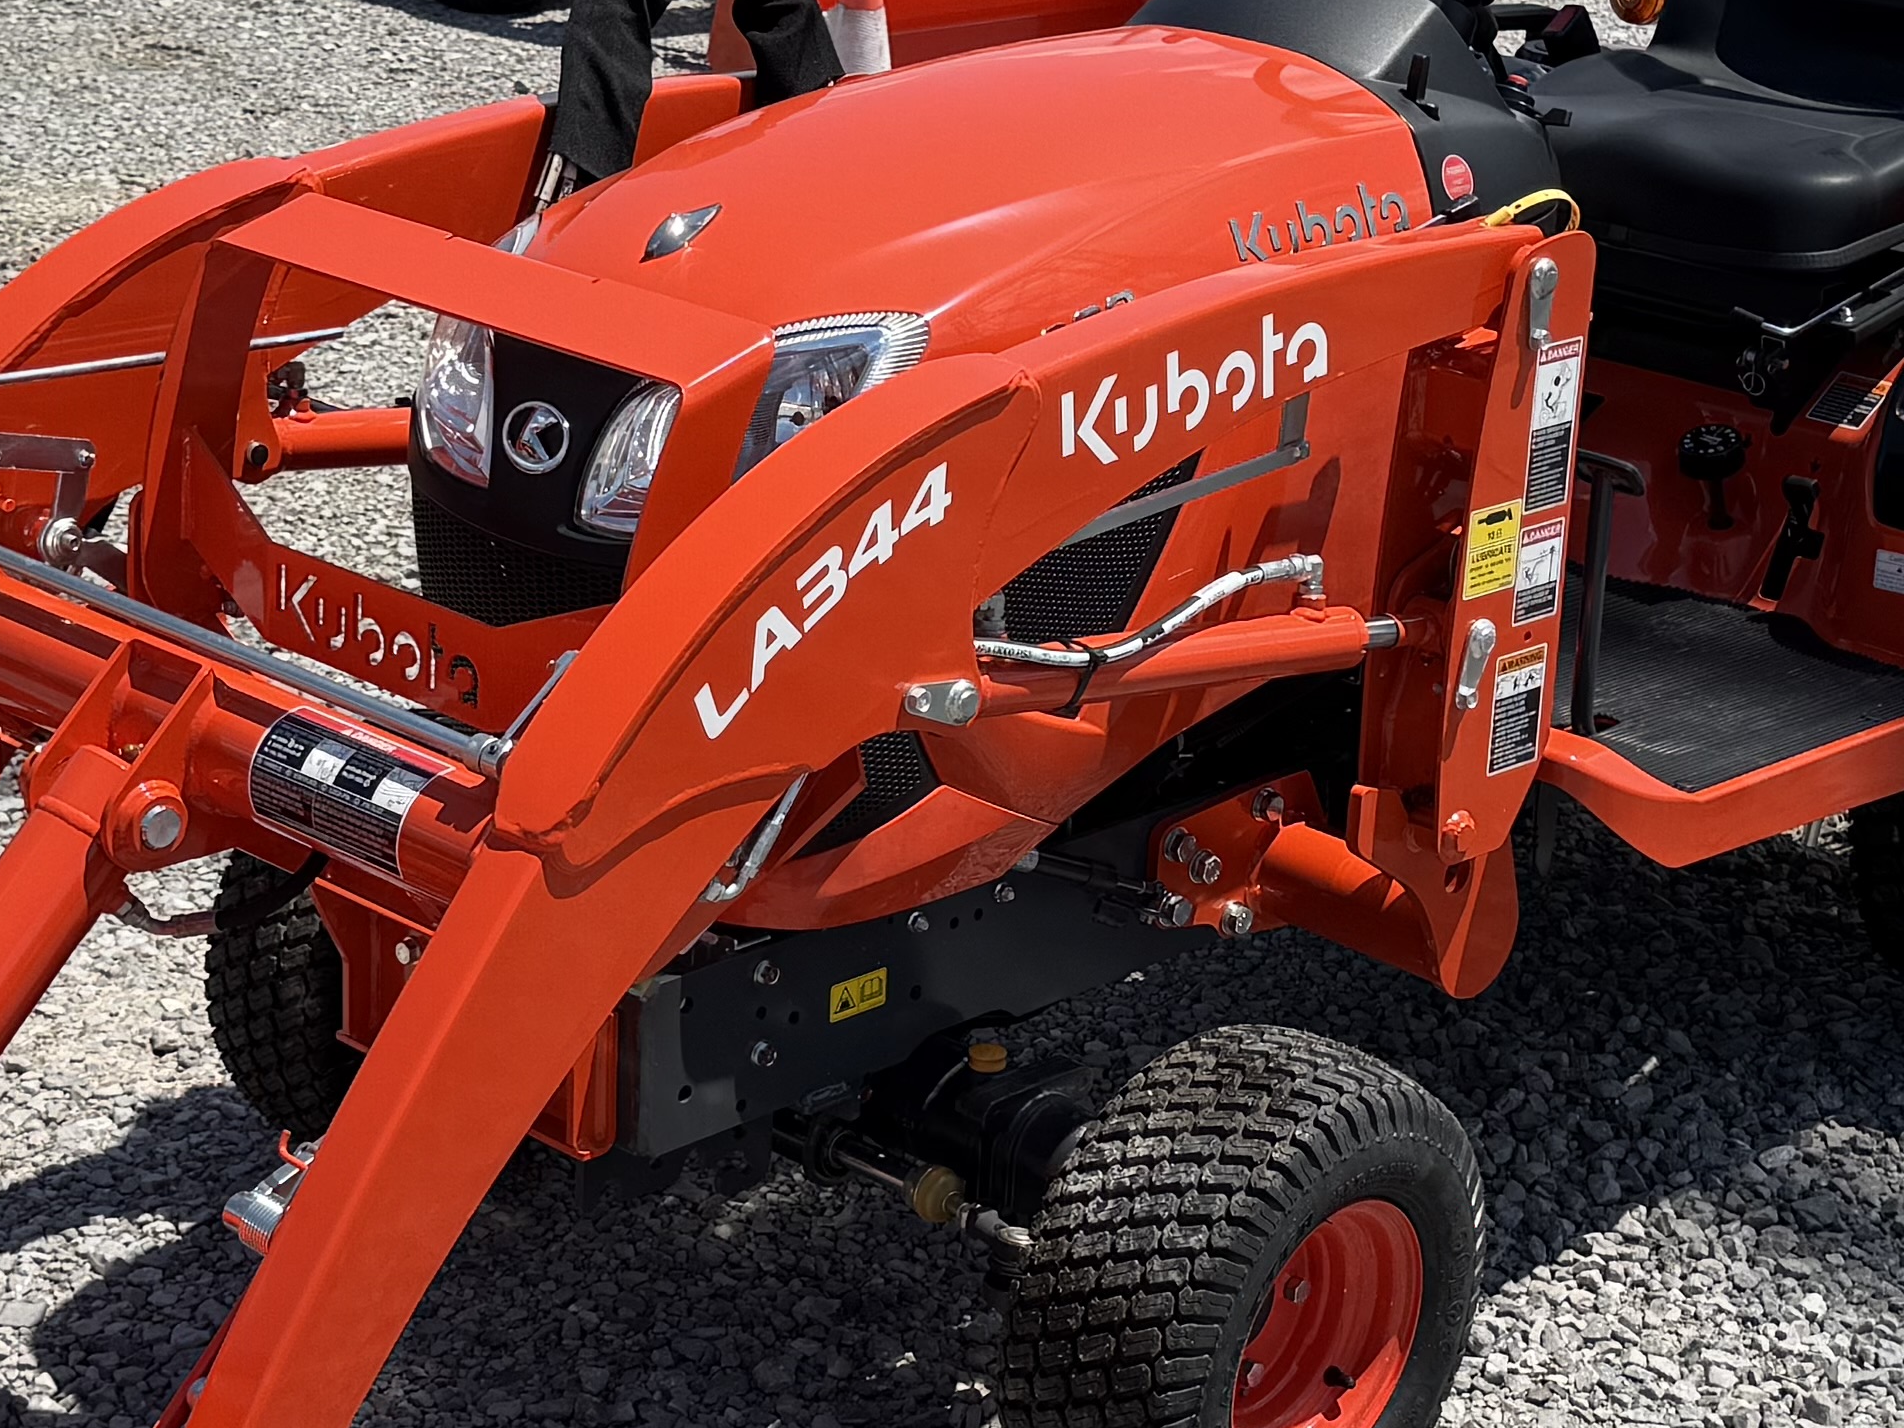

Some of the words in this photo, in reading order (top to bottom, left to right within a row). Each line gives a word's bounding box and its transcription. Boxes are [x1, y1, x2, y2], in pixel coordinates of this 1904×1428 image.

[1228, 182, 1411, 263] Kubota
[1062, 312, 1329, 465] Kubota
[278, 563, 480, 709] Kubota
[693, 461, 953, 740] LA344
